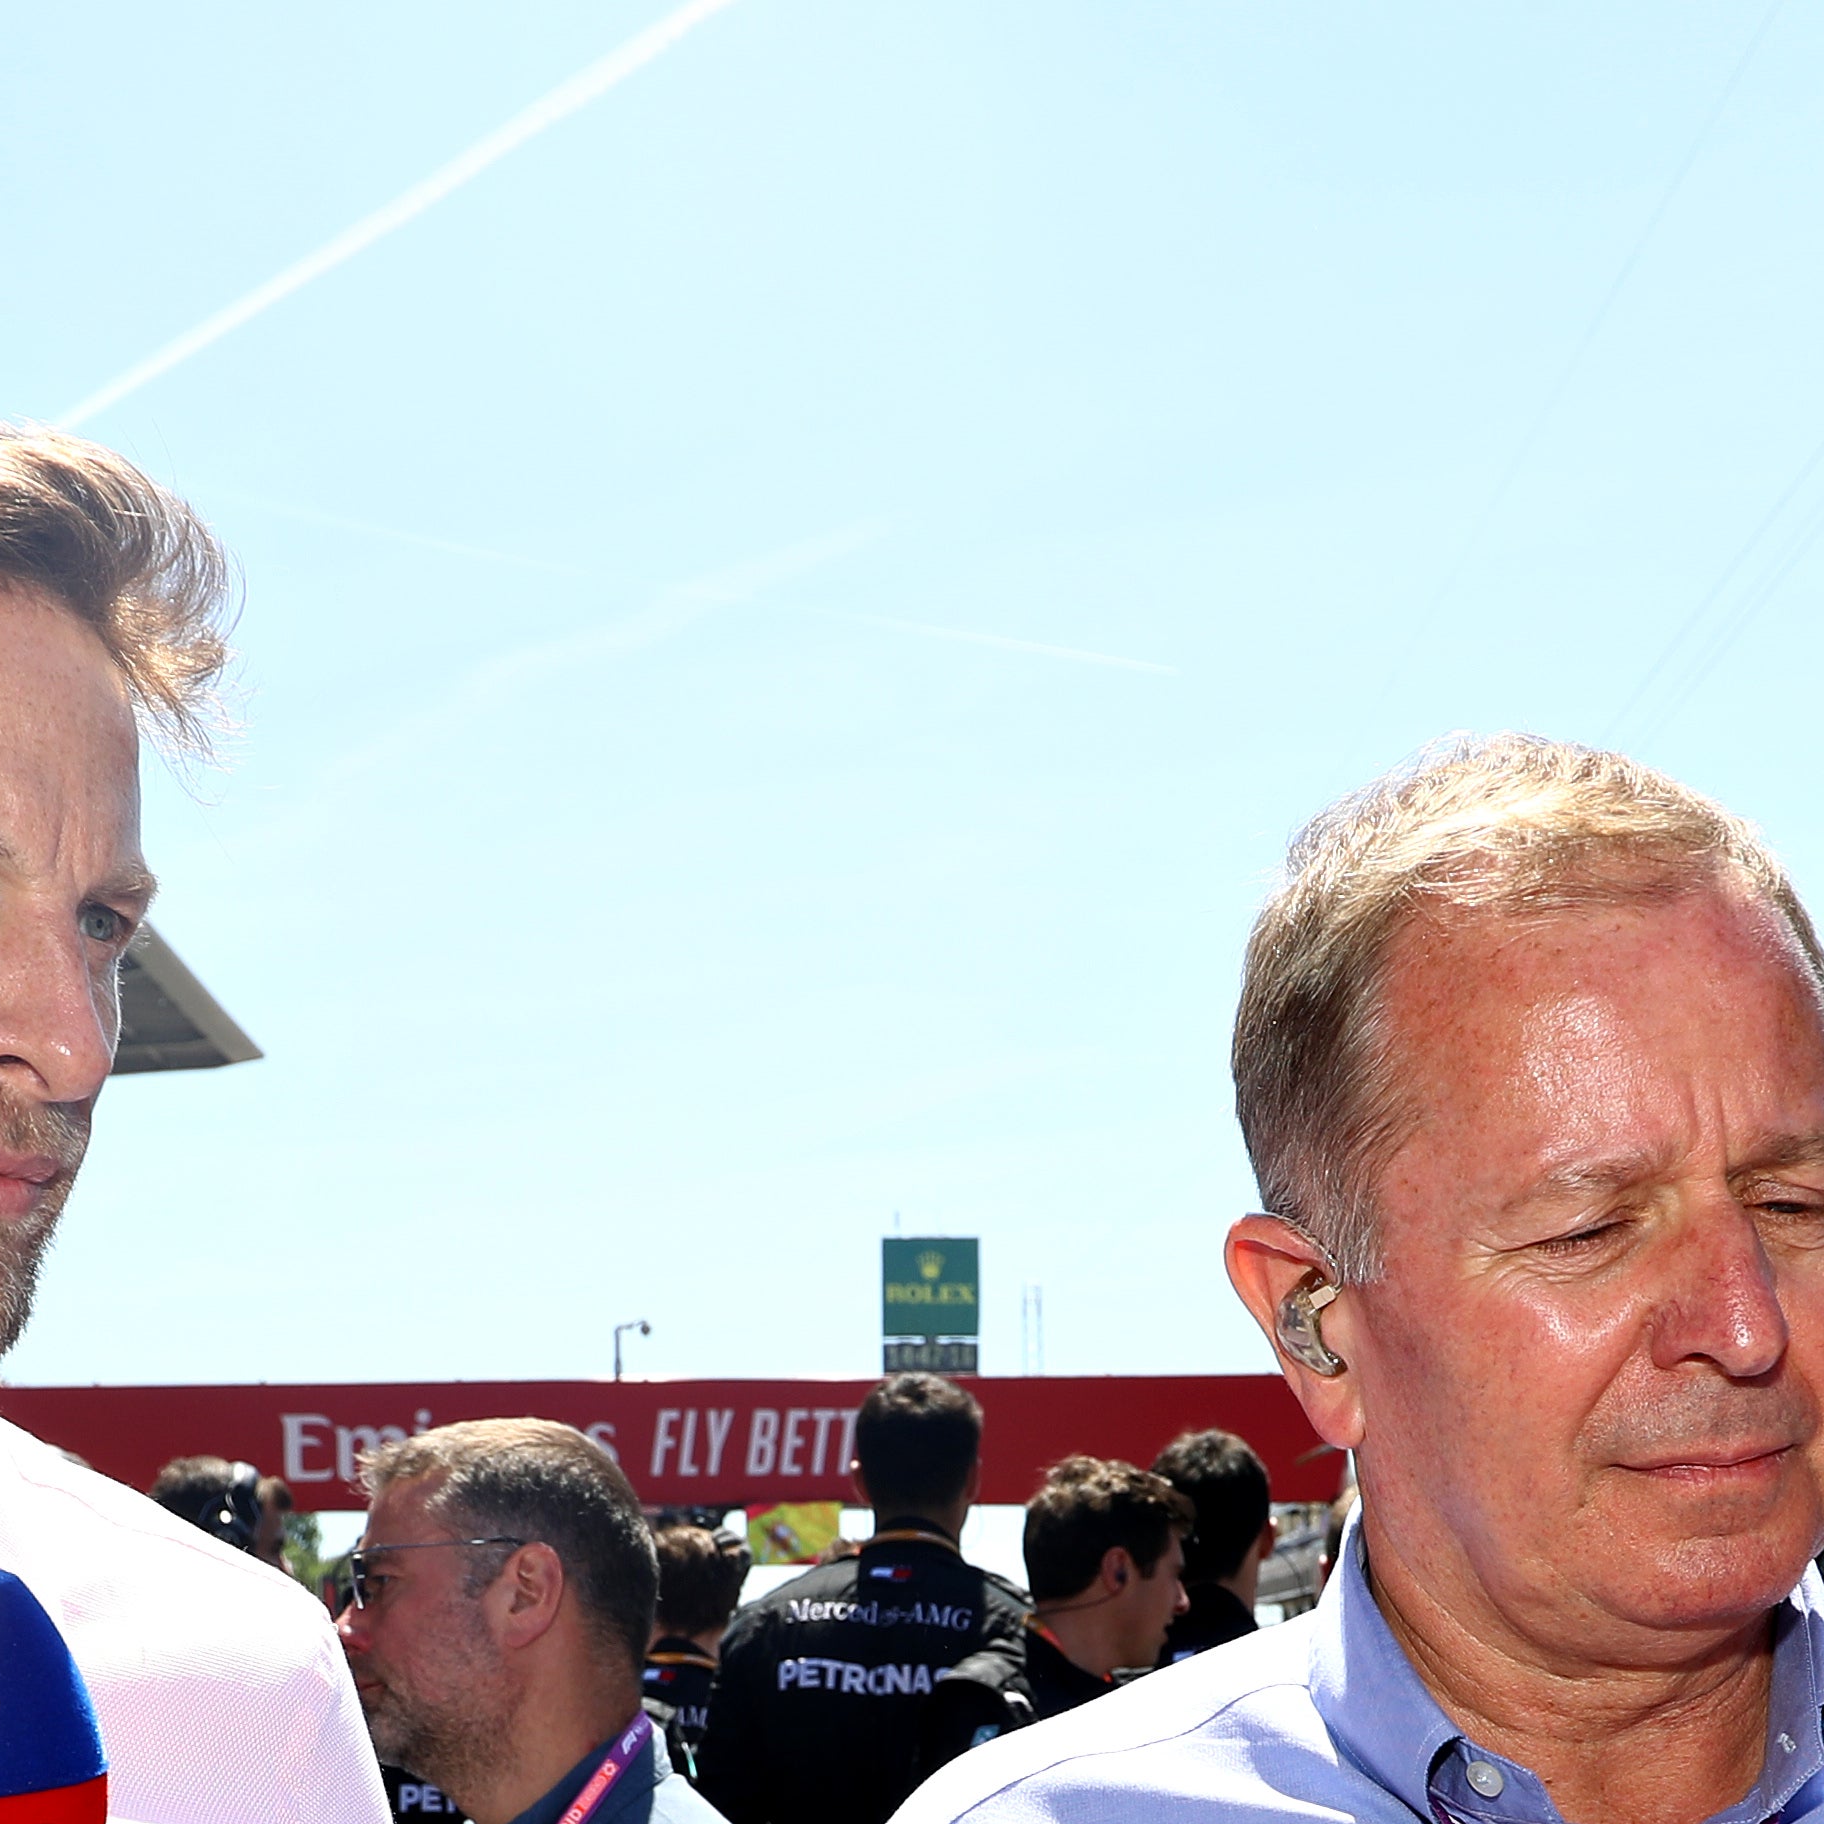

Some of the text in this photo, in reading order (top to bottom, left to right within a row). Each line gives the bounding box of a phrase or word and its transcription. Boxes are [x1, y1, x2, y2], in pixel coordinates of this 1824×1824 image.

[885, 1282, 975, 1304] ROLEX
[650, 1408, 735, 1478] FLY
[744, 1408, 860, 1478] BETT
